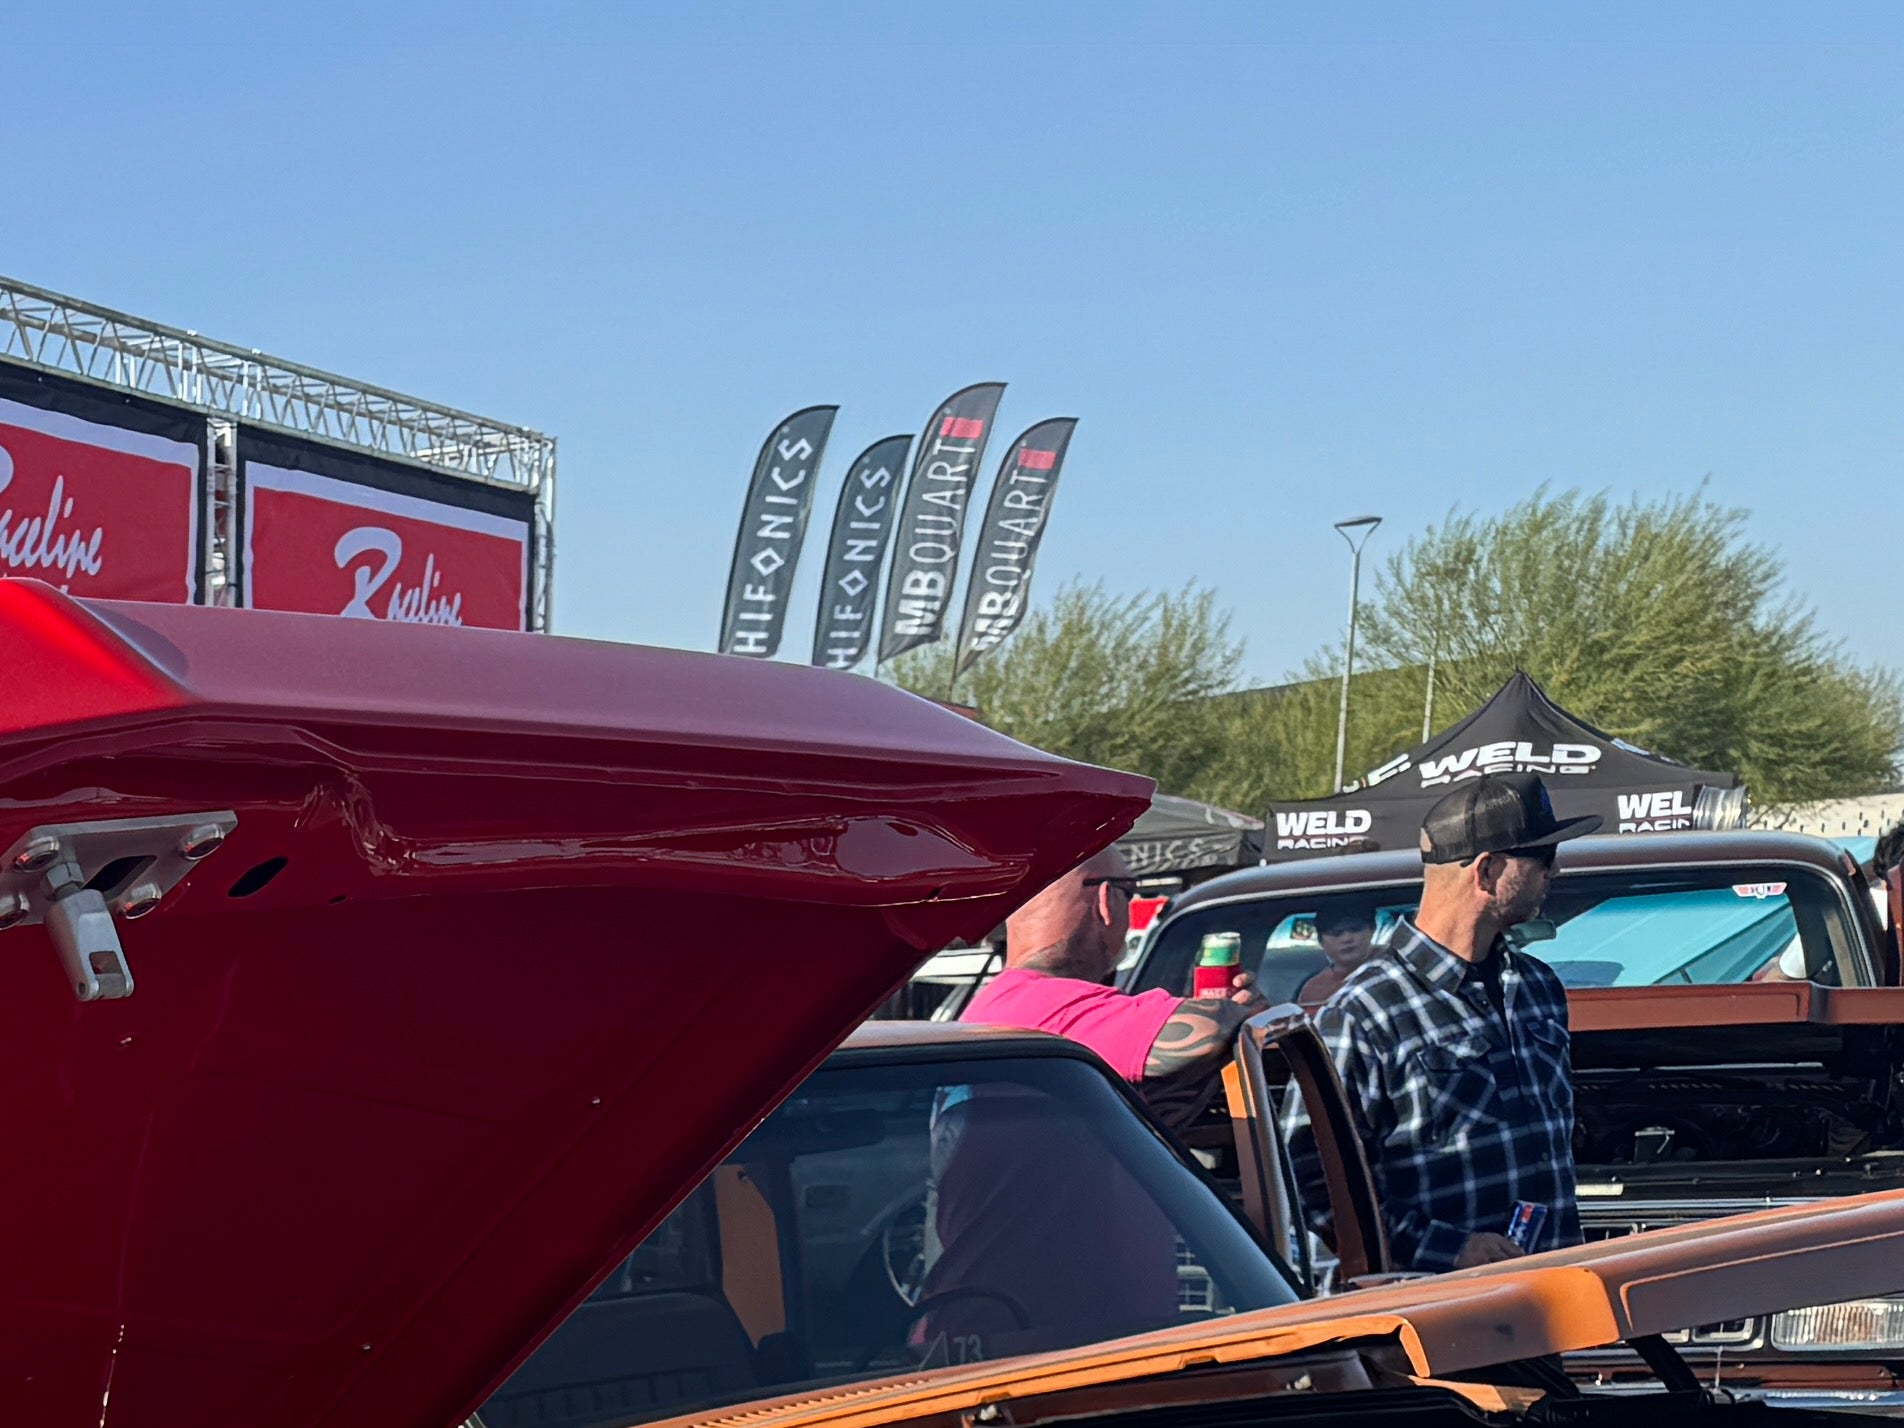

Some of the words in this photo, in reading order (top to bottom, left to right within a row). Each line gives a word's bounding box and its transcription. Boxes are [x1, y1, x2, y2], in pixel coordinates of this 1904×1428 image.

[733, 437, 813, 654] HIFONICS
[334, 526, 464, 627] Raceline
[825, 466, 892, 670] HIFONICS
[1418, 741, 1602, 780] WELD
[1276, 809, 1372, 836] WELD
[1617, 790, 1692, 820] WEL
[1618, 818, 1691, 834] RACIN
